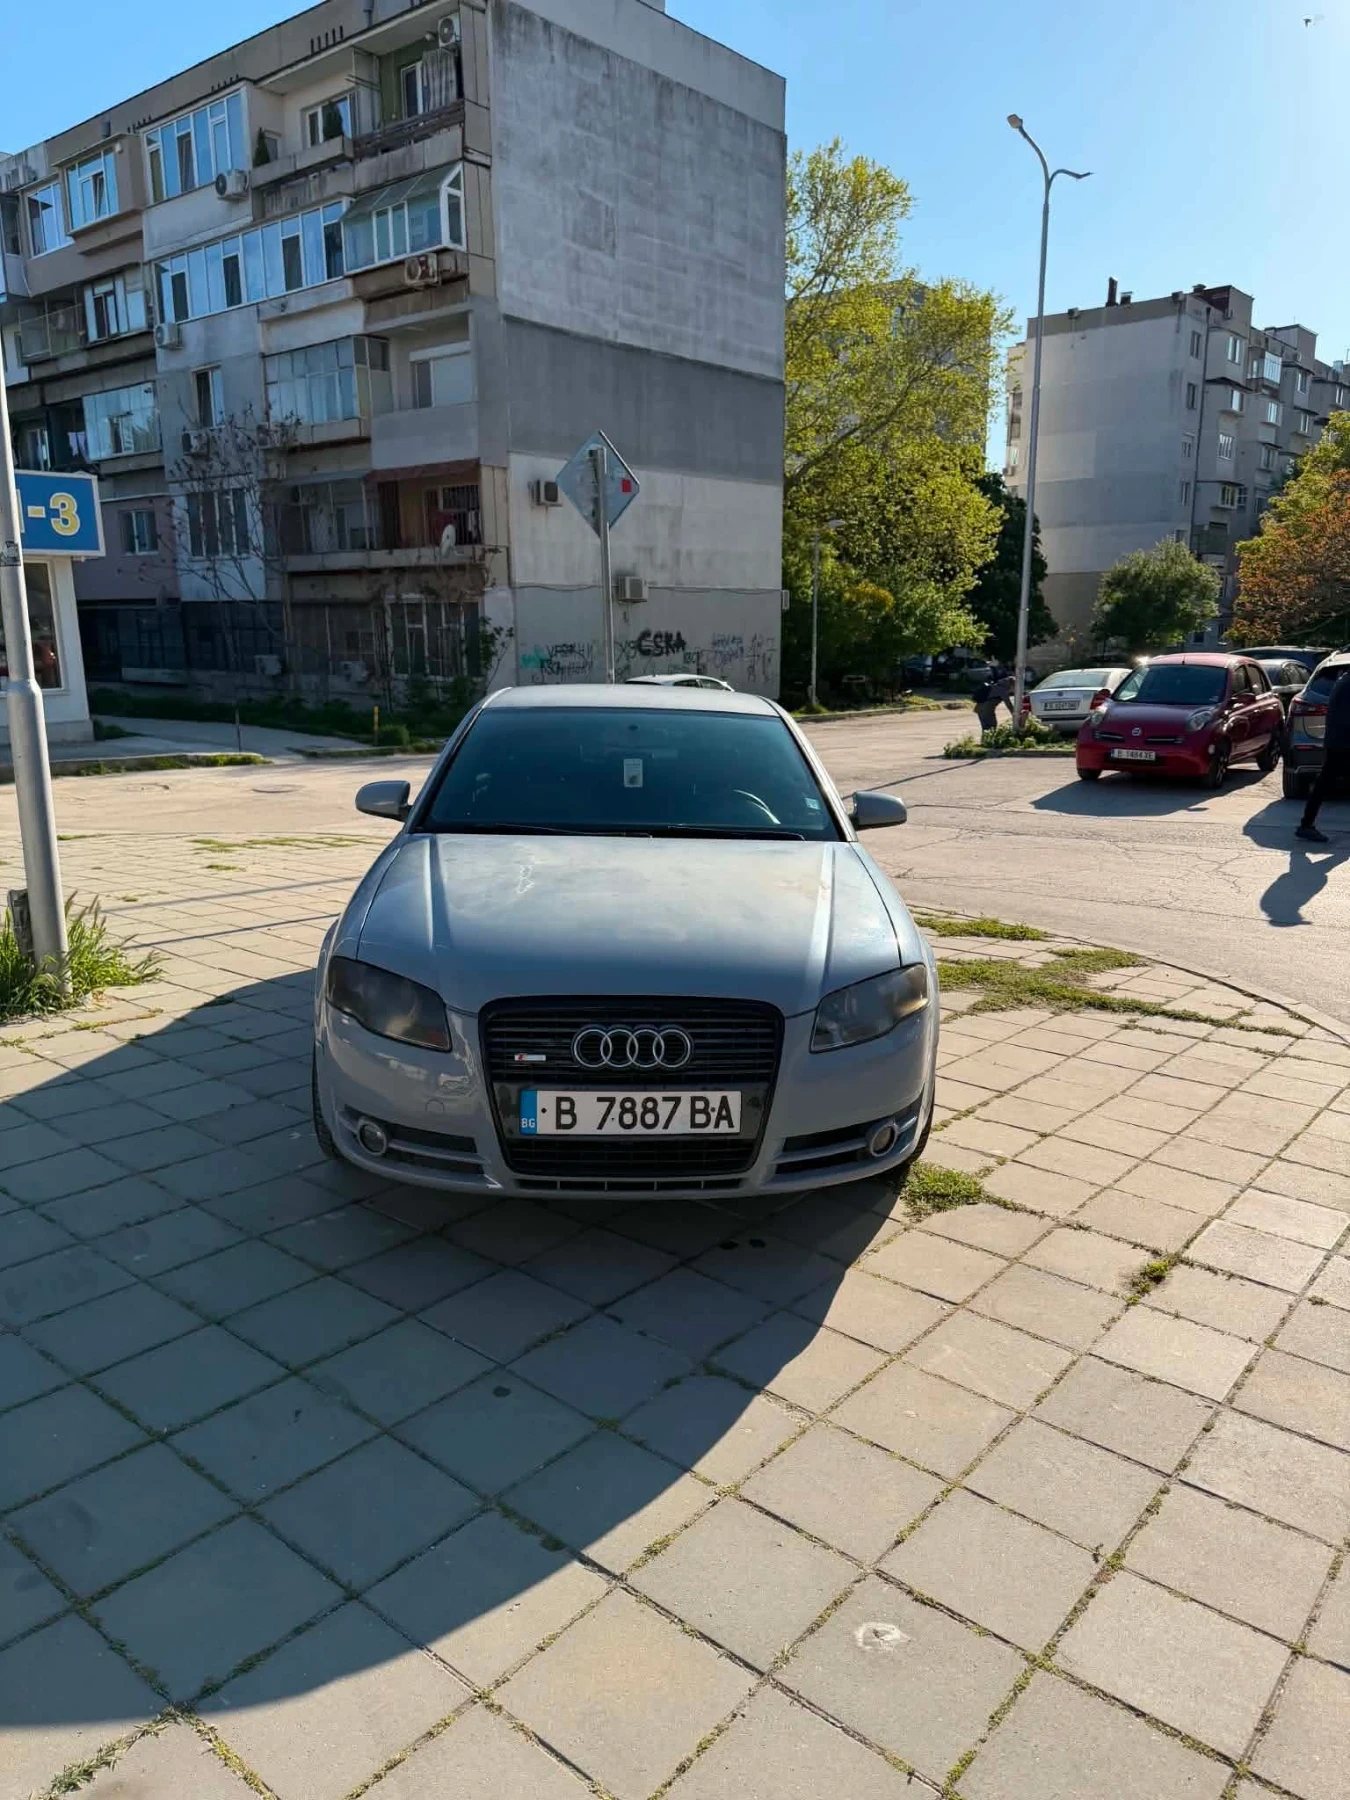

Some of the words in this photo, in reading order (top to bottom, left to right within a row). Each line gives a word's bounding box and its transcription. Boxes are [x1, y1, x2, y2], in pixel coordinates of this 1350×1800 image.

[520, 1117, 536, 1129] BG
[555, 1096, 577, 1130] B
[596, 1096, 682, 1130] 7887
[689, 1095, 735, 1130] BA
